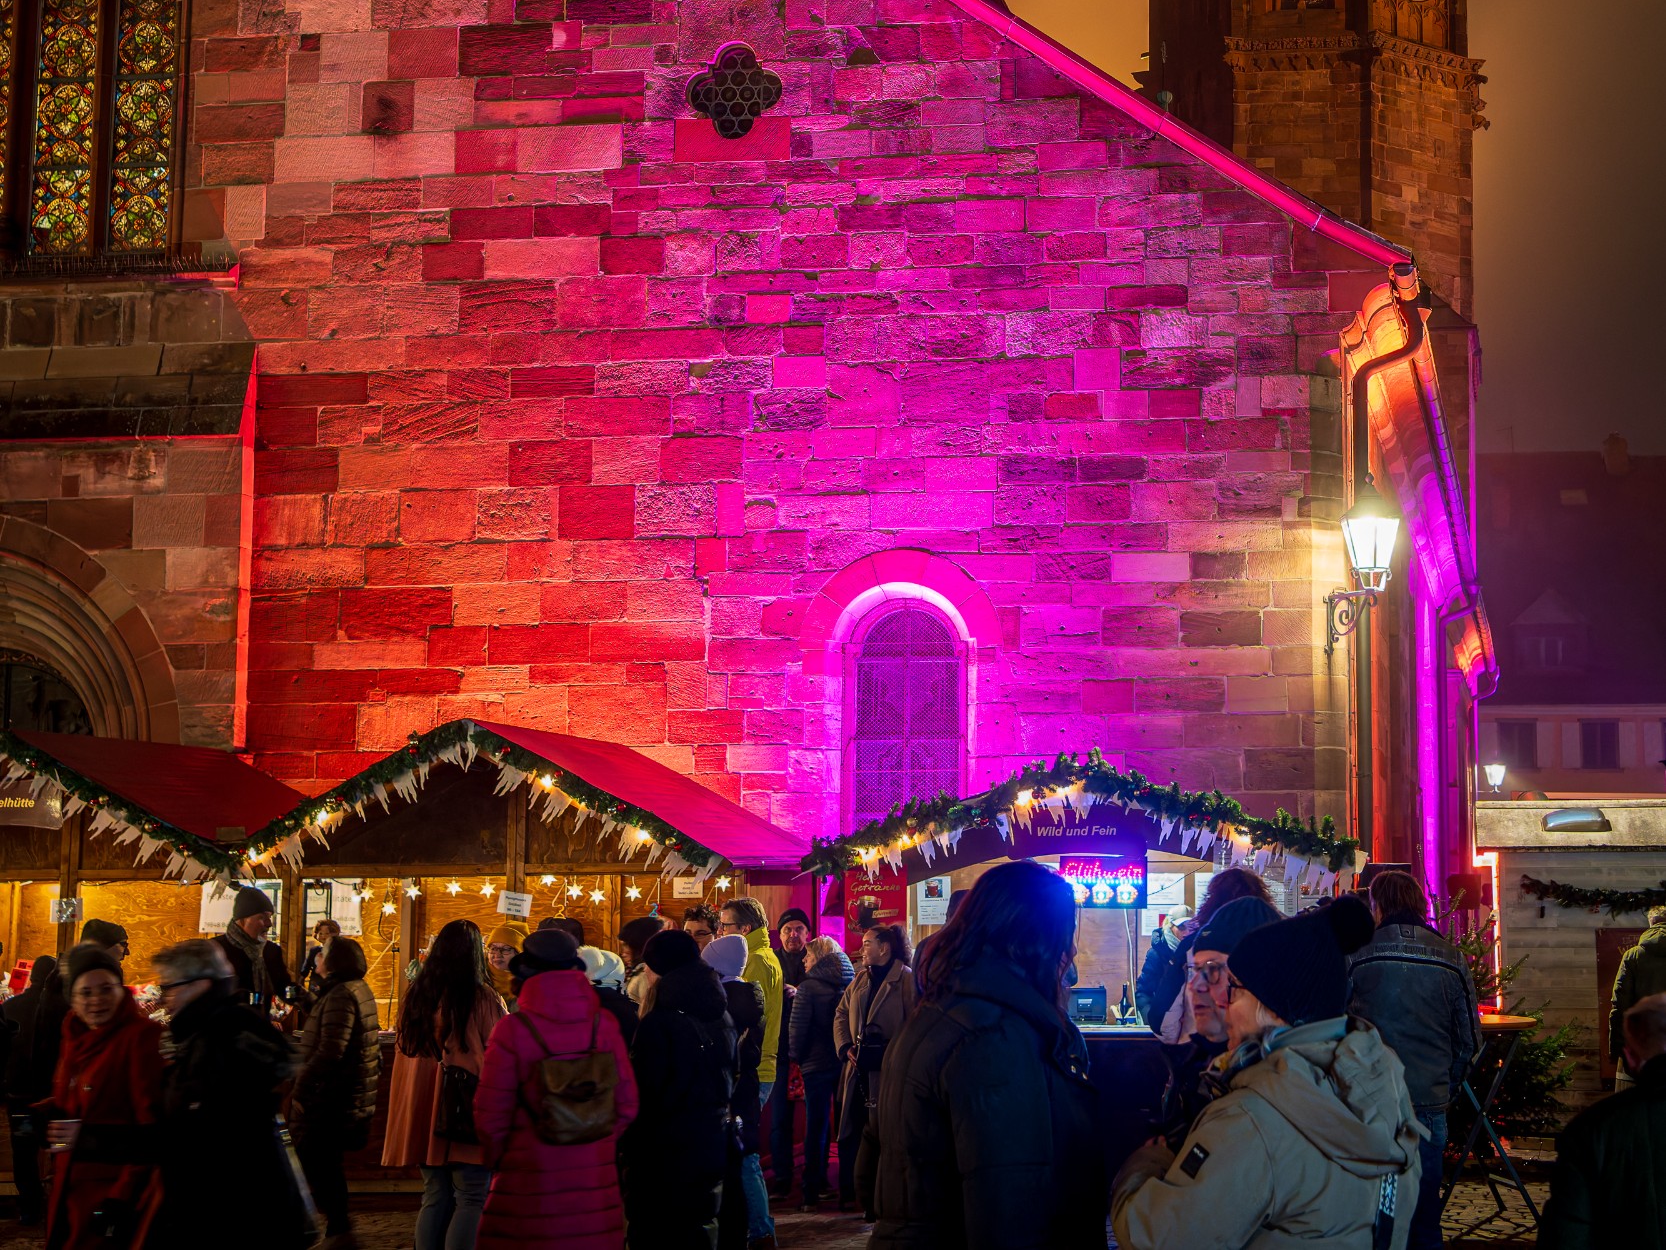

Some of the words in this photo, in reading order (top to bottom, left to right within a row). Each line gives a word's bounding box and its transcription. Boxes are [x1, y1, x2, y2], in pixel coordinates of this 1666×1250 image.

[1037, 826, 1063, 837] Wild
[1066, 826, 1088, 837] und
[1092, 825, 1117, 836] Fein
[1065, 862, 1142, 878] Glühwein
[850, 882, 901, 895] Getränke
